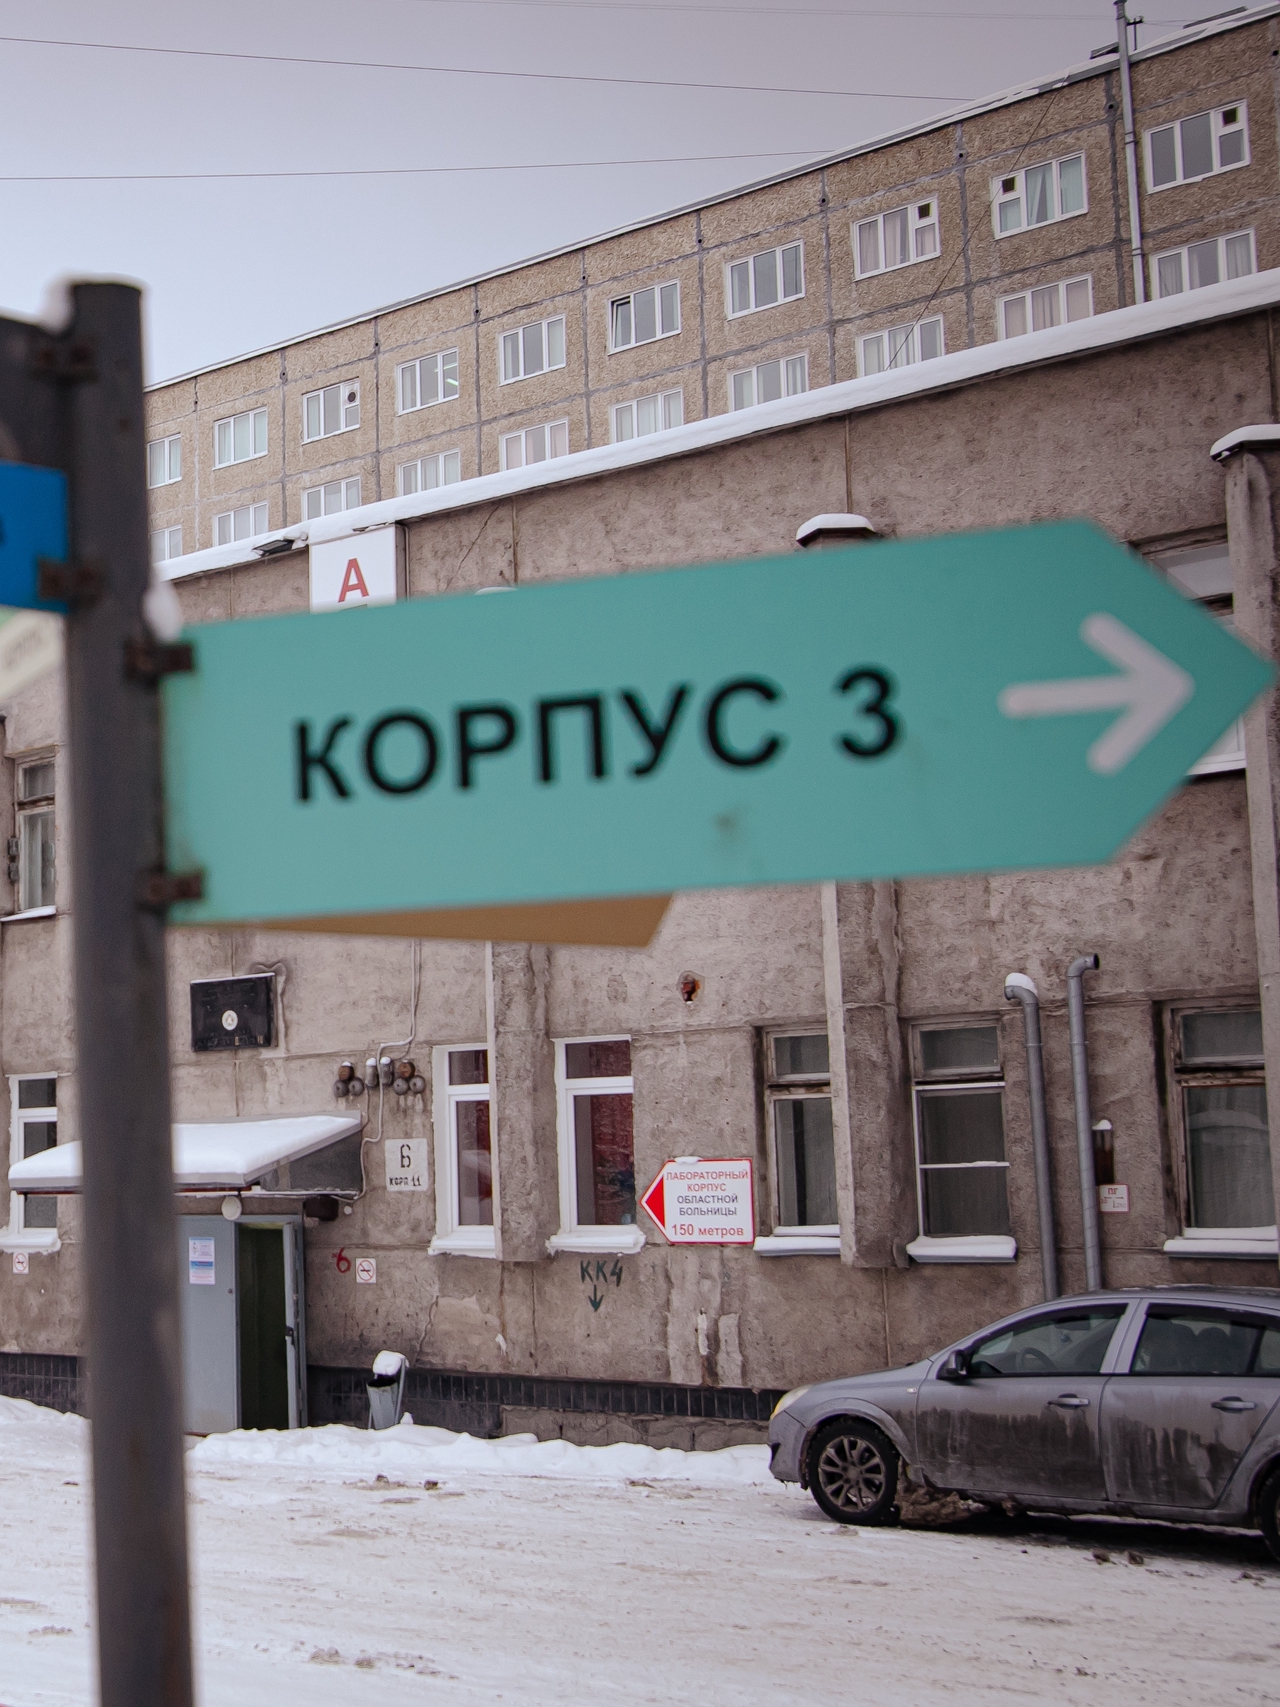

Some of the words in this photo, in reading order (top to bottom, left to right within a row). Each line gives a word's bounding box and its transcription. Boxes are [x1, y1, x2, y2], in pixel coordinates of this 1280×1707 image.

[337, 557, 369, 604] А
[293, 673, 783, 804] КОРПУС
[832, 663, 906, 764] 3
[666, 1169, 749, 1181] ЛАБОРАТОРНЫЙ
[687, 1183, 727, 1193] КОРПУС
[676, 1193, 739, 1204] ОБЛАСТНОЙ
[678, 1206, 738, 1217] БОЛЬНИЦЫ
[671, 1223, 694, 1236] 150
[697, 1226, 745, 1239] метров
